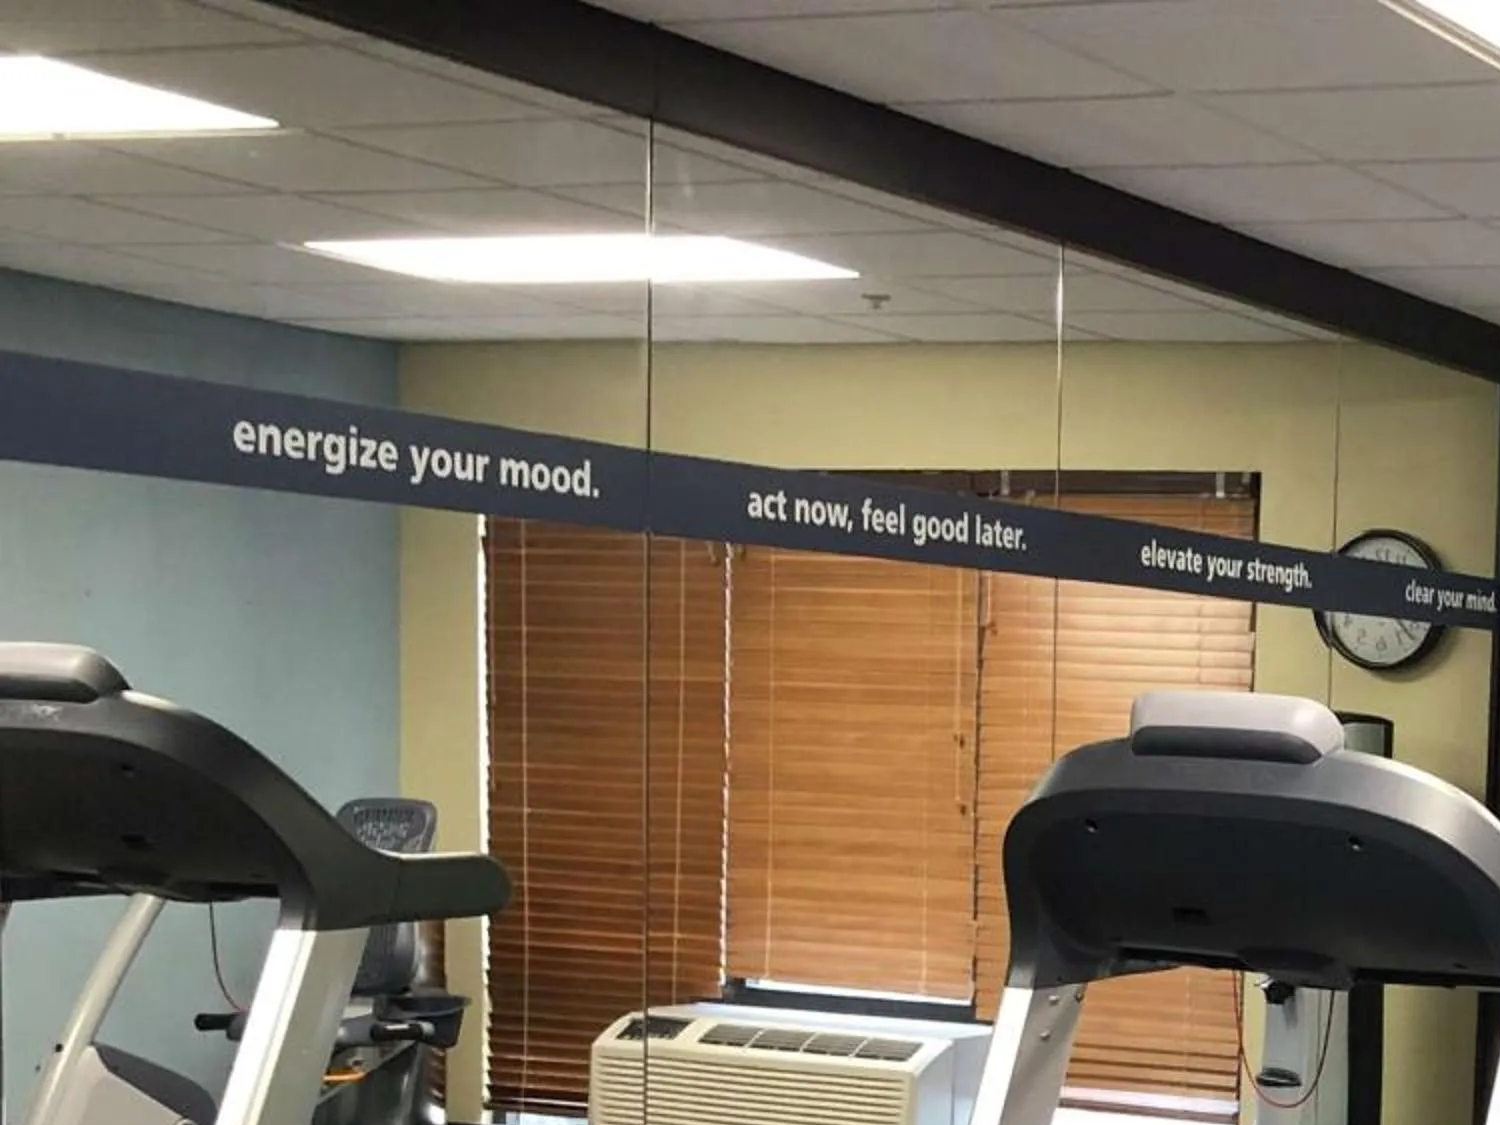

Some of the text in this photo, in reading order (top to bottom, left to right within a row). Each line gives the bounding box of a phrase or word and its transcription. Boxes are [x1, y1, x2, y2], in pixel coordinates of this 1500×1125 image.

[233, 418, 600, 499] energize your mood.
[747, 490, 1027, 551] act now, feel good later.
[1140, 539, 1313, 593] elevate your strength.
[1405, 579, 1498, 613] clear your mind.
